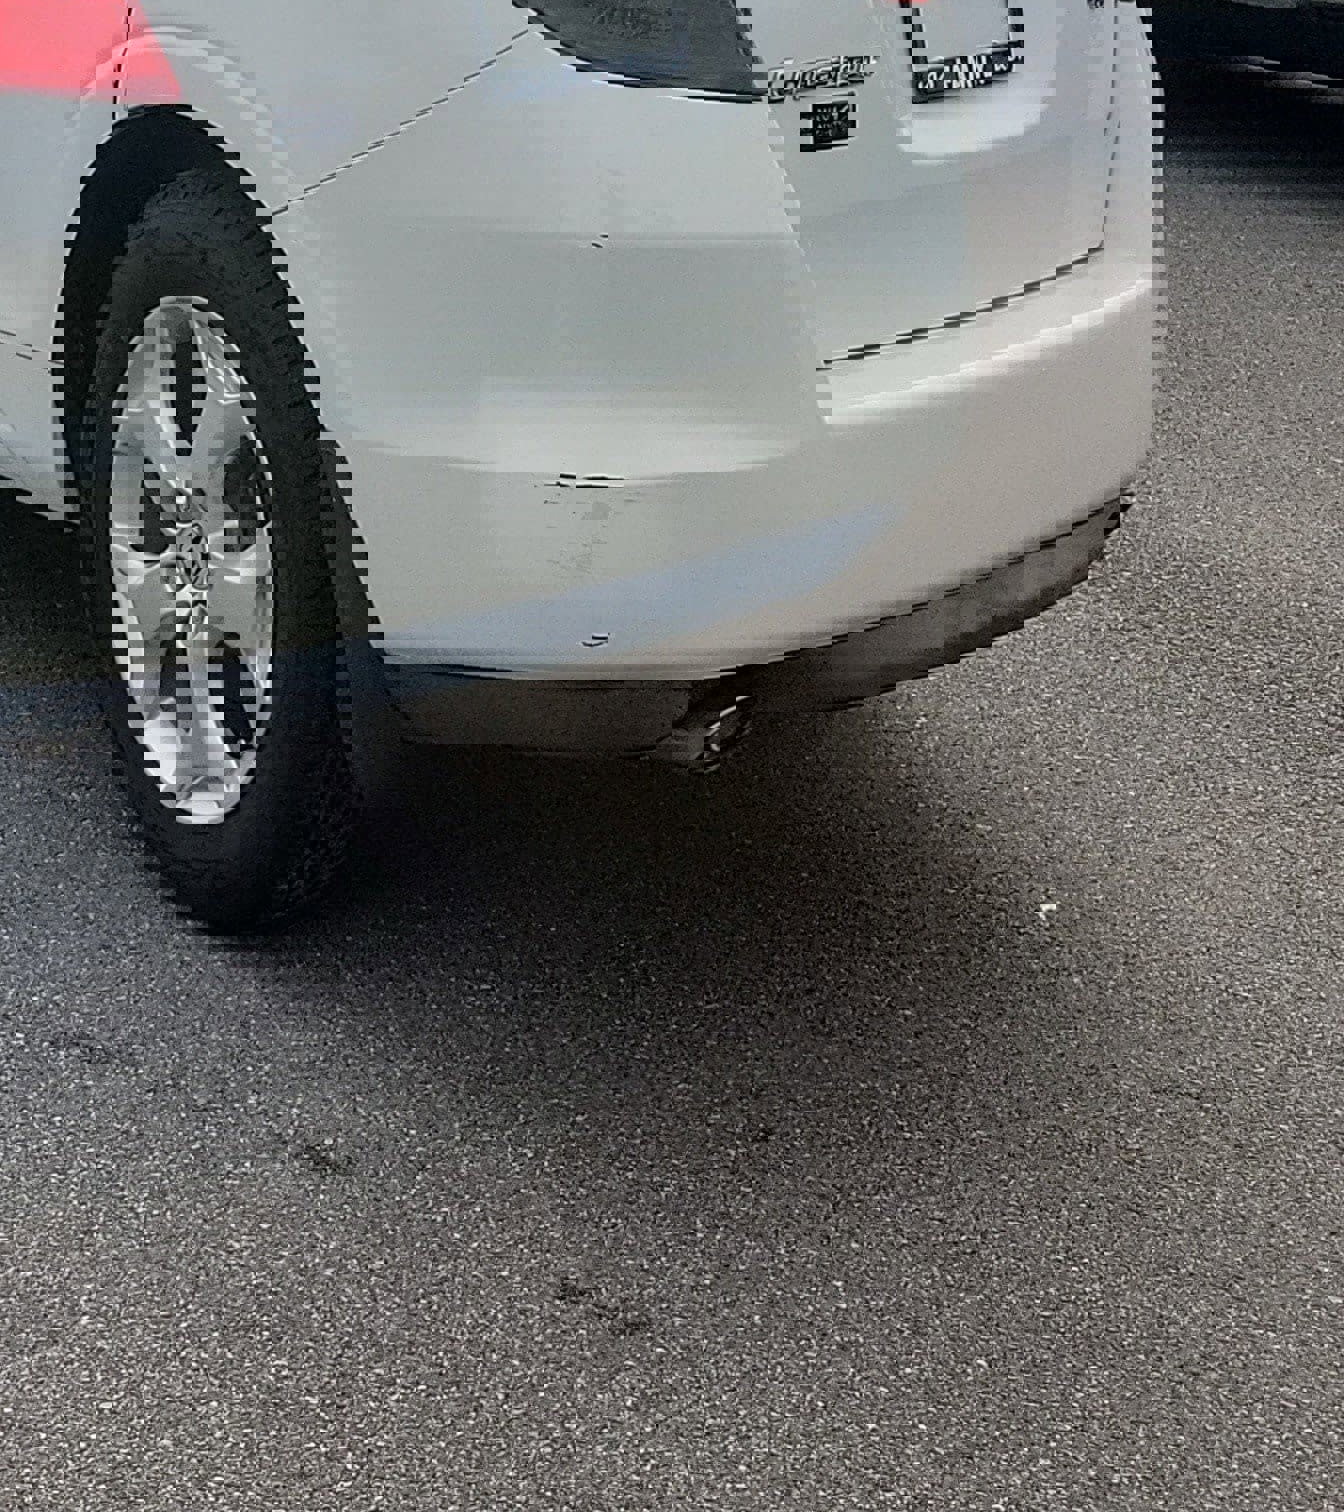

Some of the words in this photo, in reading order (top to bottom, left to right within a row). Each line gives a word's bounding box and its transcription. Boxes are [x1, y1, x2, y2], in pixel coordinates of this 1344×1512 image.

[195, 55, 407, 107] Crosstour
[556, 56, 634, 94] FAMILY
[273, 114, 317, 131] FAMILY
